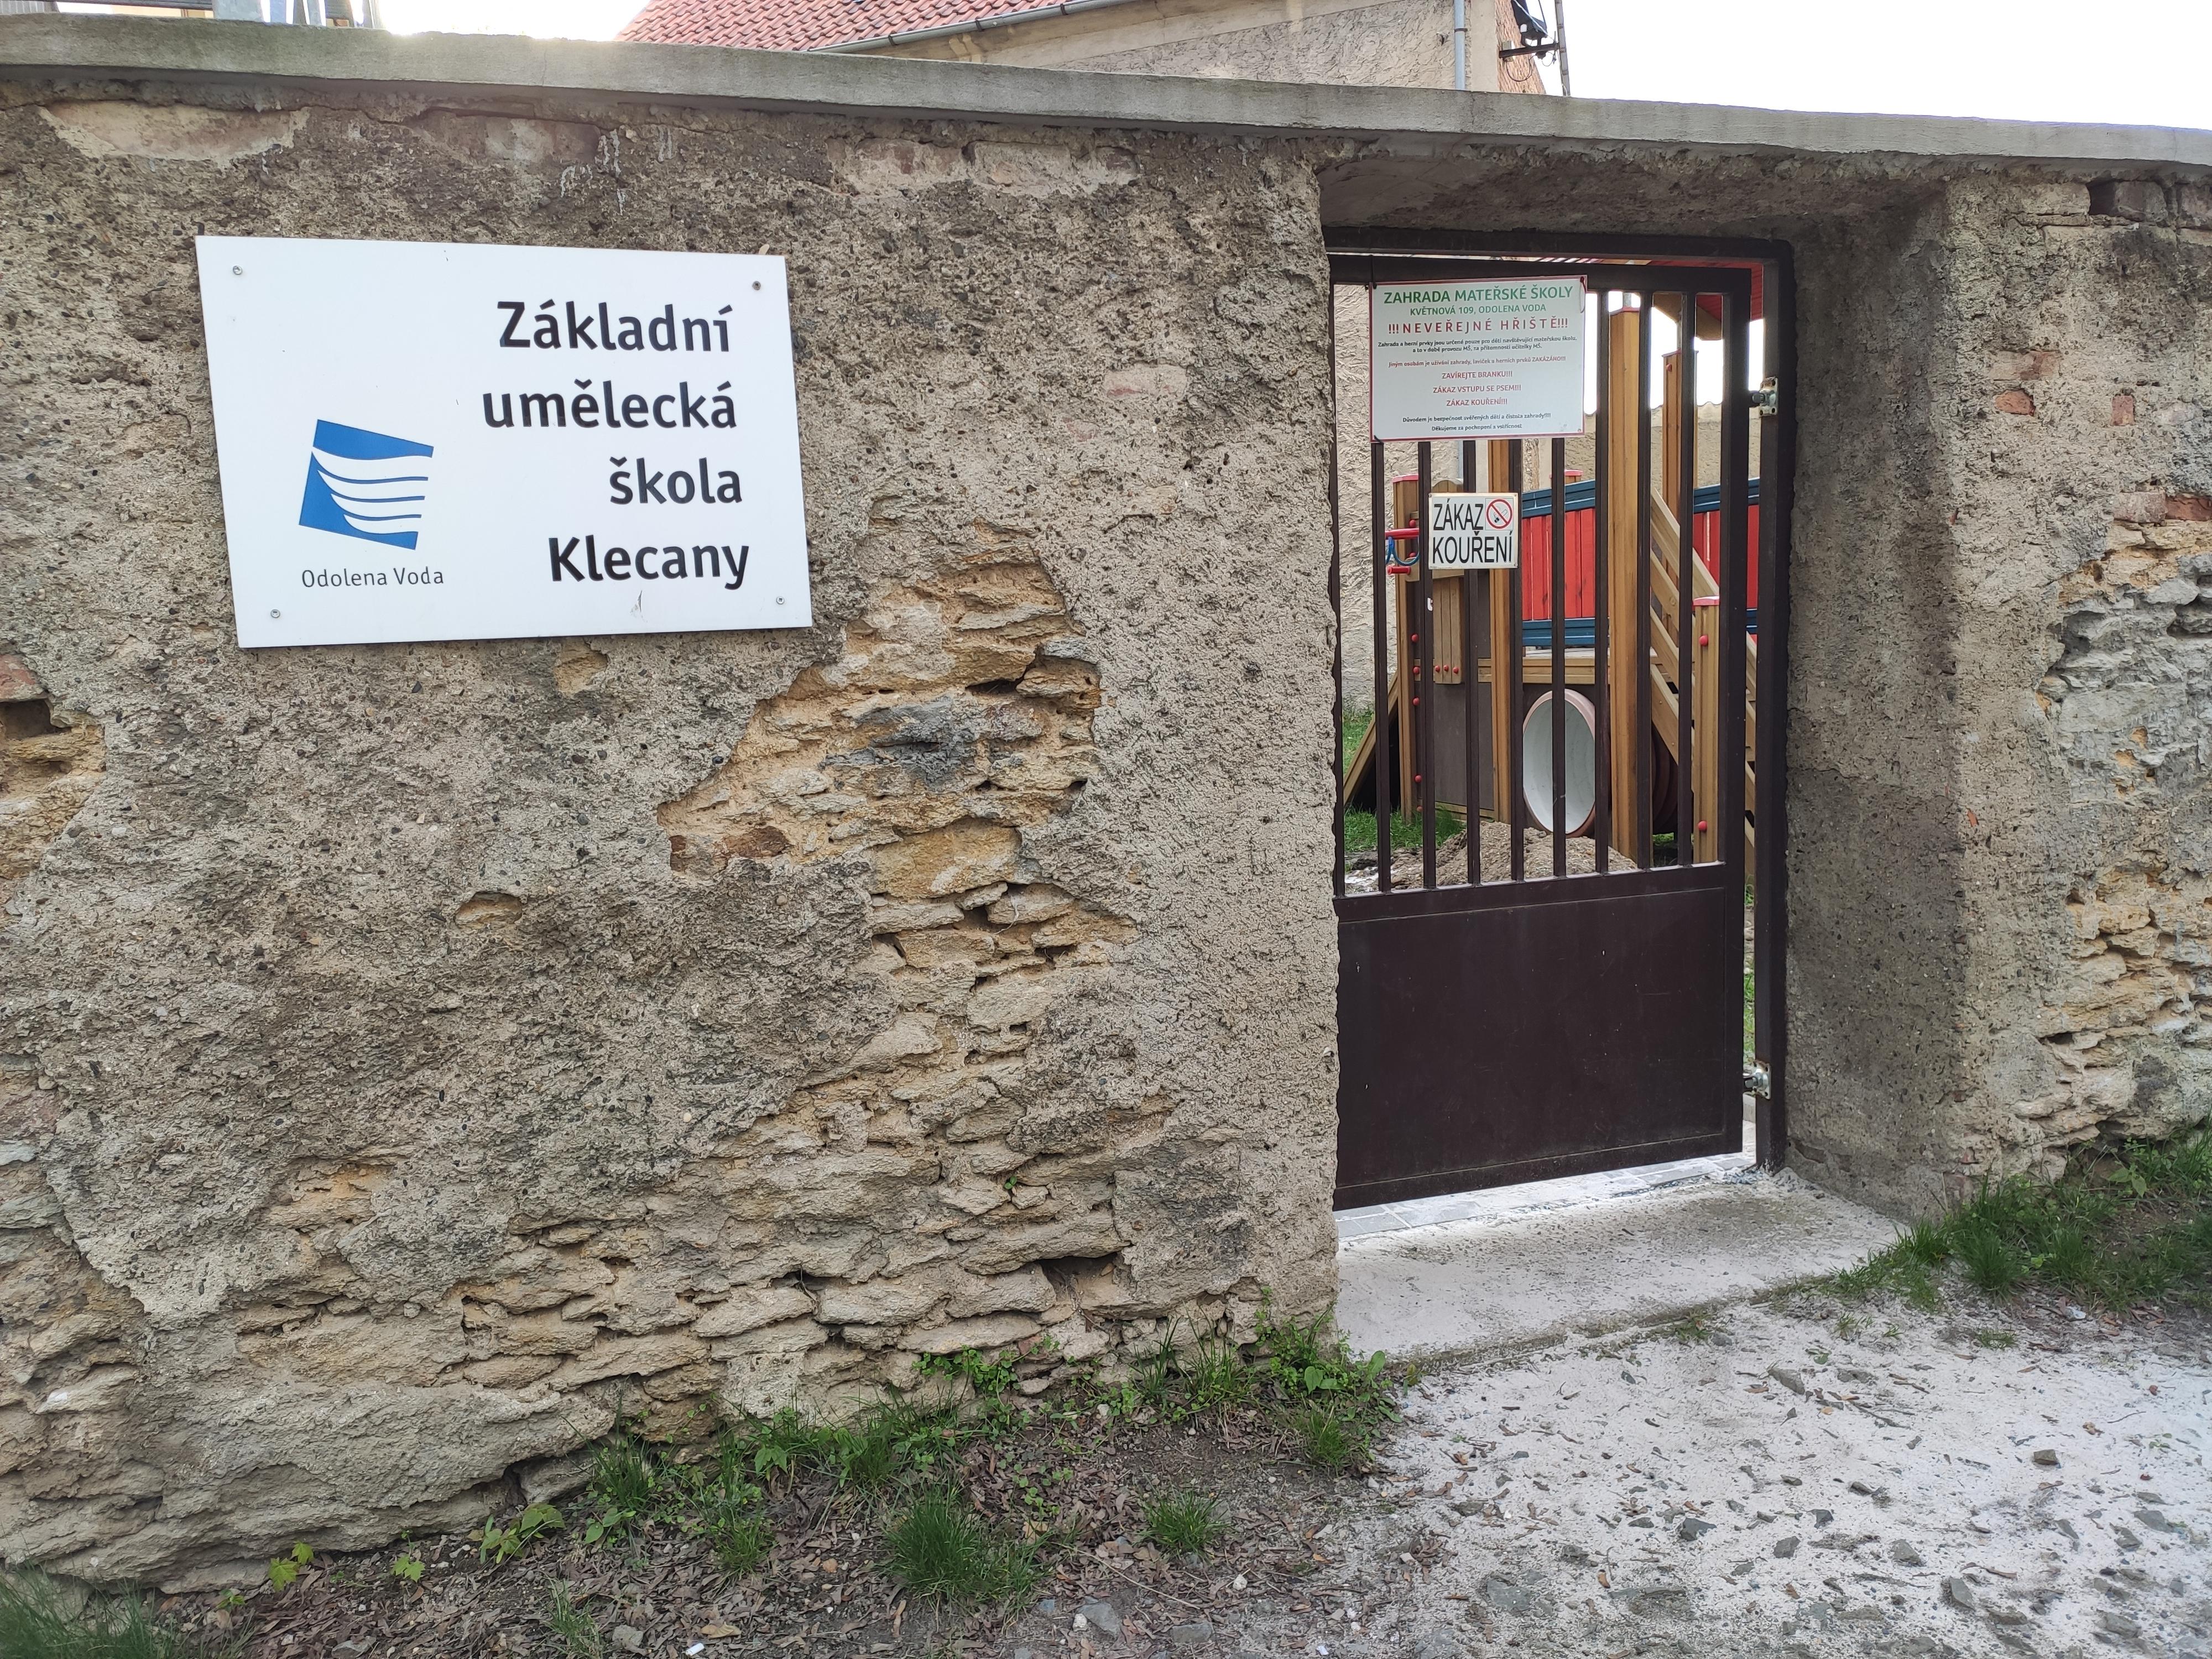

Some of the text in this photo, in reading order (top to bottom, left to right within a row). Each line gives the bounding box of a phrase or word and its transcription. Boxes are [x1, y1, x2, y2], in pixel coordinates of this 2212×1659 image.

[1384, 284, 1573, 304] ZAHRADA MATEŘSKÉ ŠKOLY
[1411, 305, 1455, 316] KVĚTNOVÁ
[1459, 306, 1476, 315] 109,
[1479, 305, 1520, 314] ODOLENA
[1501, 315, 1568, 330] HŘIŠTĚ!!!
[497, 299, 733, 352] Základní
[1442, 371, 1476, 379] ZAVÍREJTE
[483, 378, 737, 429] umělecká
[1471, 397, 1507, 405] KOUŘENÍ!!!
[609, 456, 743, 504] škola
[1433, 498, 1484, 530] ZÁKAZ
[1432, 531, 1513, 564] KOUŘENÍ
[549, 535, 749, 591] Klecany
[301, 567, 444, 588] Odolena Voda
